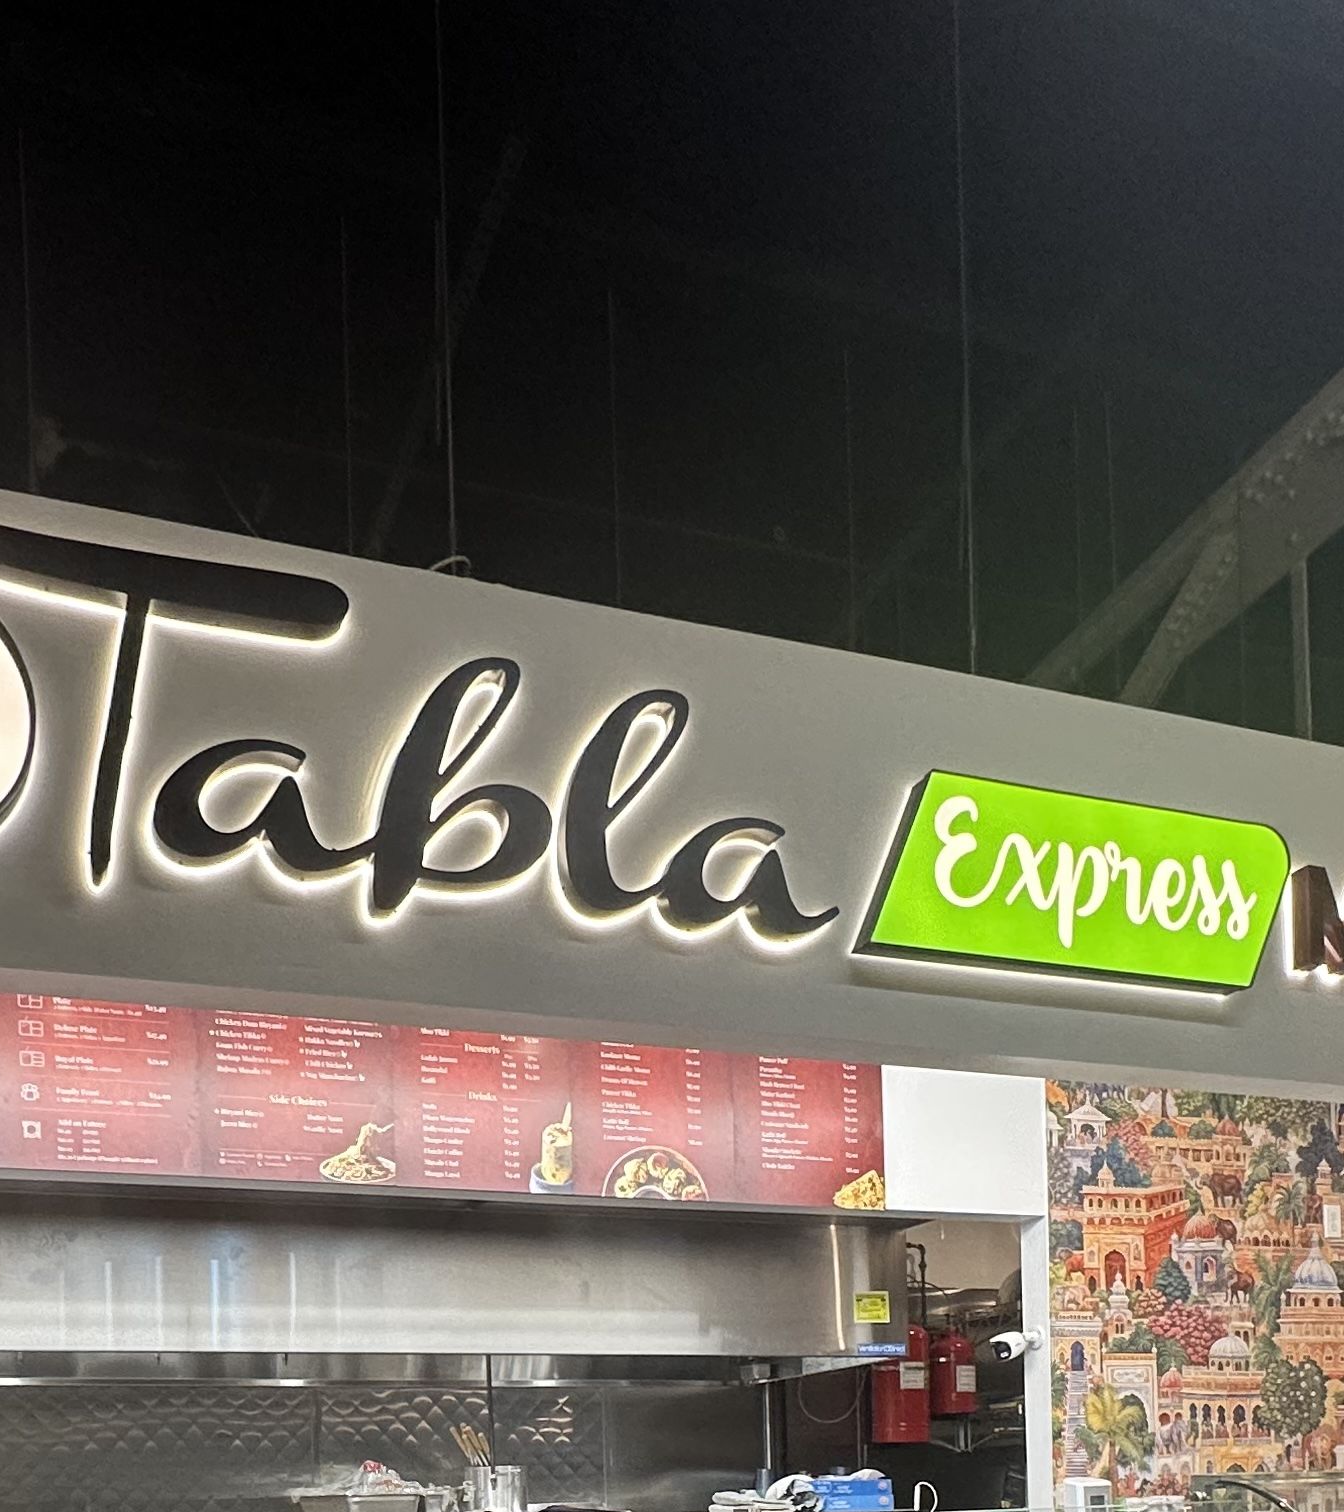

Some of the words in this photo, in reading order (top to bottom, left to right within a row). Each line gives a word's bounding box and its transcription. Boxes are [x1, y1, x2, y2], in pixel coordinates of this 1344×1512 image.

[933, 795, 1258, 949] Express
[464, 1043, 500, 1054] Desserts
[468, 1091, 498, 1101] Drinks
